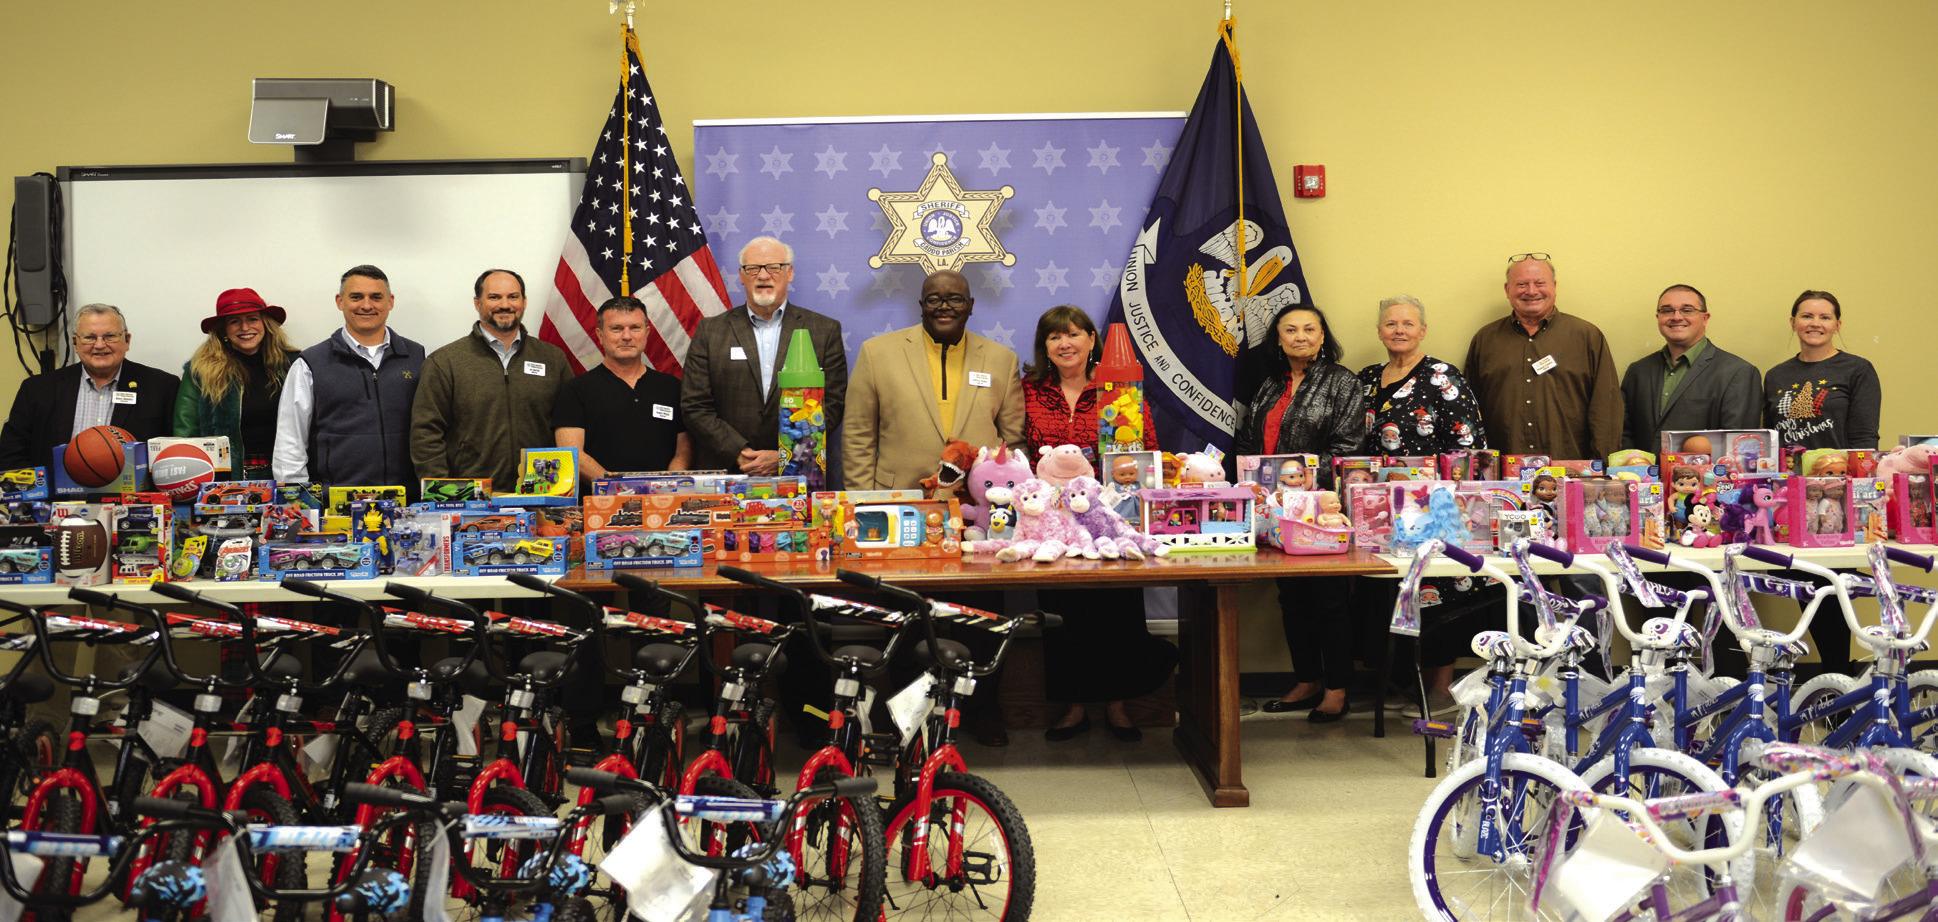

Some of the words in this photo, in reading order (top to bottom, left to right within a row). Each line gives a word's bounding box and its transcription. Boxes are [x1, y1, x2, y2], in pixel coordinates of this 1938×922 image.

[920, 201, 961, 211] SHERIFF
[920, 241, 941, 255] CADDO
[942, 241, 964, 255] PARISH
[1126, 250, 1138, 292] UNION
[1129, 302, 1158, 352] JUSTICE
[1154, 355, 1170, 372] AND
[1172, 372, 1236, 431] CONFIDENCE
[442, 536, 450, 572] TRANSFORMERS
